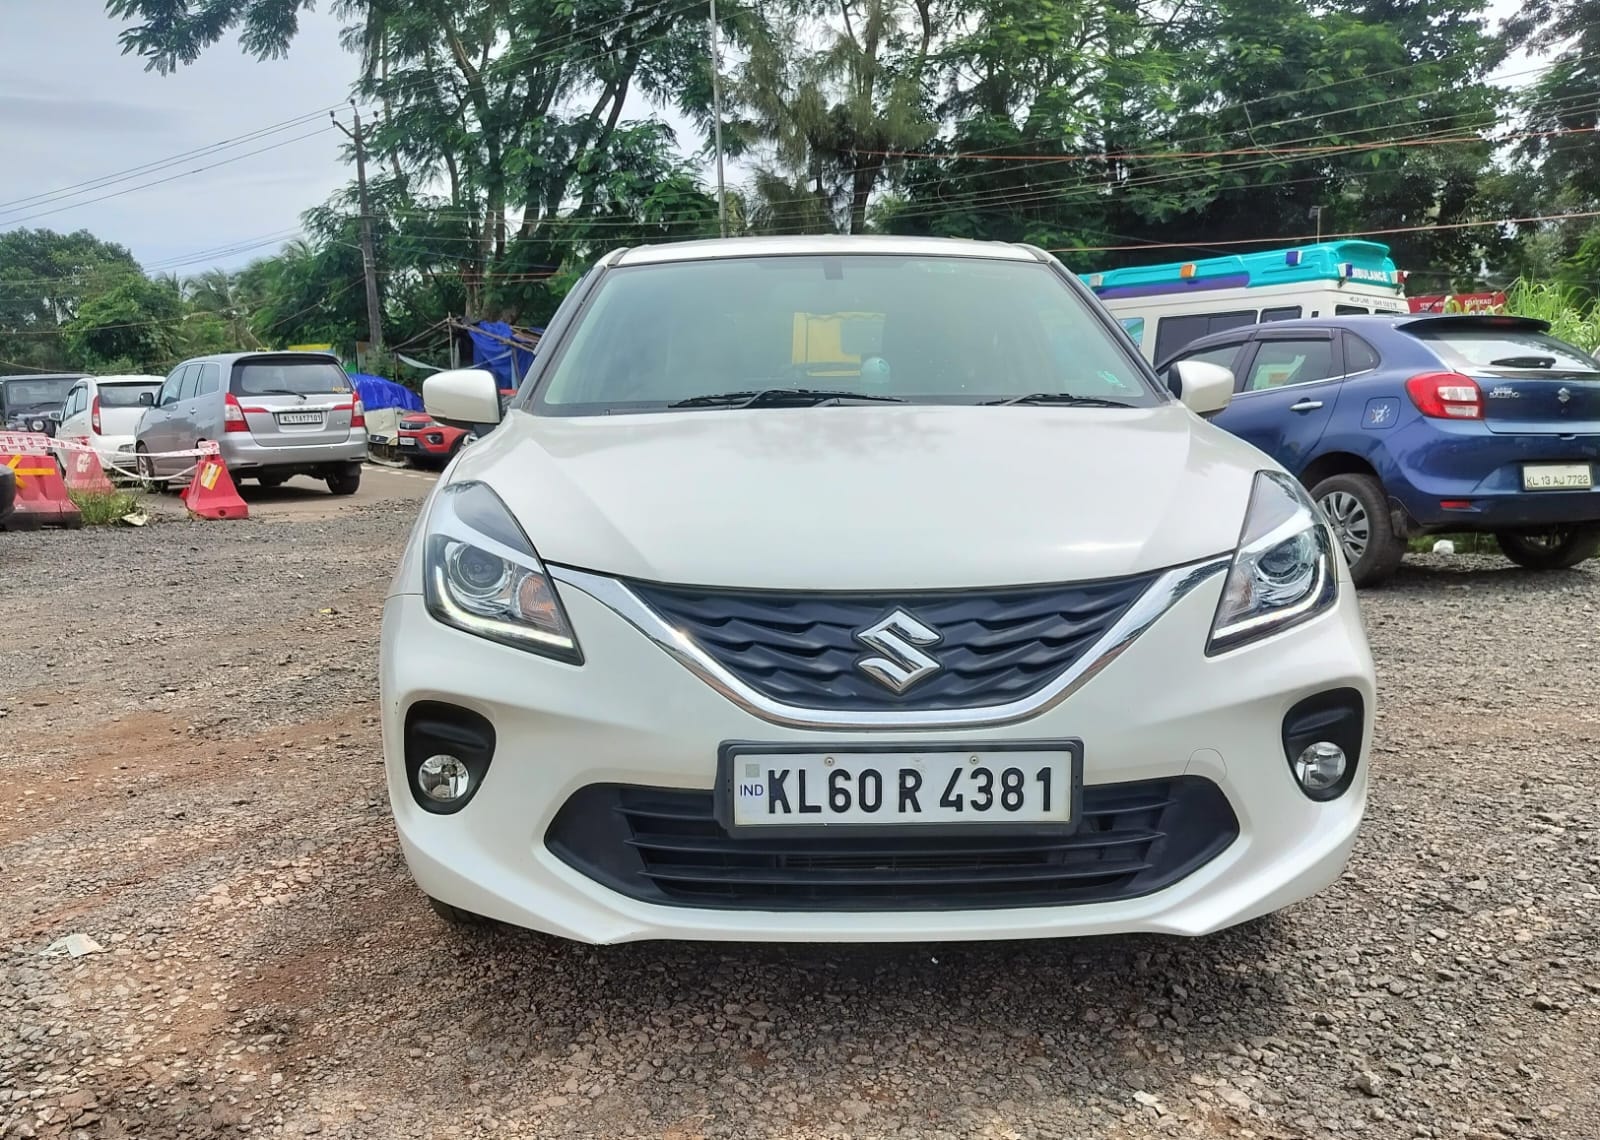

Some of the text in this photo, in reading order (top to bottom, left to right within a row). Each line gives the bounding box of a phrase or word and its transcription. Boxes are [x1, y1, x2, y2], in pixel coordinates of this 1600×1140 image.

[1352, 268, 1388, 282] MBULANCE
[1527, 474, 1589, 487] KL 13 AJ 7722
[740, 784, 764, 797] IND
[768, 767, 1051, 814] KL60 R 4381
